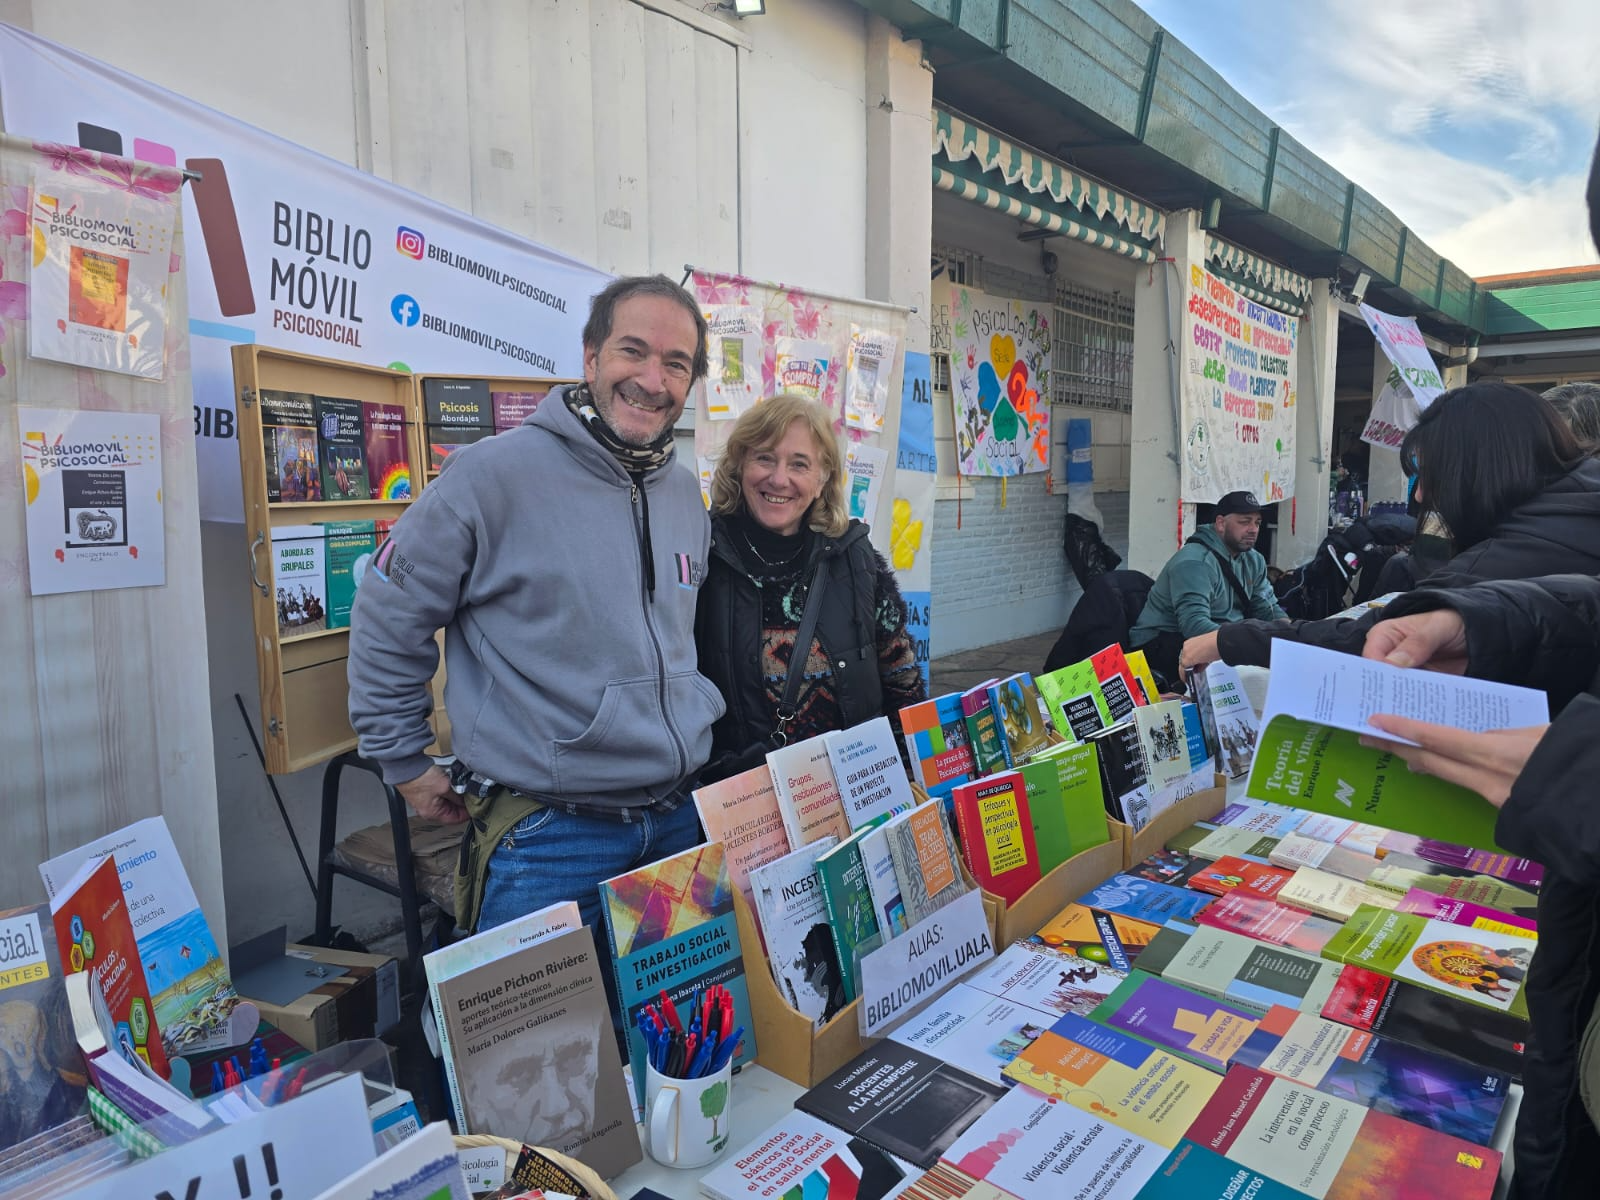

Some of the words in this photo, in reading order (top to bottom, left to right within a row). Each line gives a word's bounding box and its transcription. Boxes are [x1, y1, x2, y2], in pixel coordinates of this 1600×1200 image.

[50, 224, 137, 249] PSICOSOCIAL
[52, 211, 134, 237] BIBLIOMOVIL
[273, 201, 372, 270] BIBLIO
[269, 256, 364, 323] MÓVIL
[427, 244, 568, 314] BIBLIOMOVILPSICOSOCIAL
[273, 309, 362, 348] PSICOSOCIAL
[422, 313, 557, 376] BIBLIOMOVILPSICOSOCIAL
[440, 401, 479, 413] Psicosis
[441, 414, 480, 424] Abordajes
[40, 442, 124, 457] BIBLIOMOVIL
[41, 454, 127, 469] PSICOSOCIAL
[280, 547, 314, 558] ABORDAJES
[281, 560, 314, 572] GRUPALES
[938, 765, 963, 780] Psicología
[943, 753, 959, 767] praxis
[1265, 739, 1294, 791] Teoría
[788, 773, 814, 789] Grupos,
[857, 767, 871, 783] PARA
[864, 775, 885, 793] PROYECTO
[1285, 769, 1304, 796] del
[1304, 759, 1321, 799] Enrique
[792, 781, 833, 803] instituciones
[801, 791, 842, 816] comunidades
[1364, 775, 1386, 815] Nueva
[983, 798, 1006, 812] Enfoques
[984, 809, 1015, 826] perspectivas
[992, 819, 1018, 838] psicología
[996, 832, 1012, 846] social
[849, 851, 858, 864] LA
[782, 871, 819, 902] INCEST
[140, 893, 156, 906] una
[134, 905, 166, 928] colectiva
[1096, 915, 1114, 938] GRUPAL
[632, 942, 686, 975] TRABAJO
[689, 925, 727, 950] SOCIAL
[908, 924, 944, 962] ALIAS:
[457, 985, 504, 1013] Enrique
[504, 969, 545, 992] Pichon
[545, 952, 589, 976] Rivière:
[635, 978, 644, 992] E
[679, 982, 702, 998] Ibaceta
[867, 932, 991, 1028] BIBLIOMOVIL.UALA
[461, 1006, 490, 1026] aportes
[491, 981, 552, 1012] teórico-técnicos
[463, 1025, 474, 1036] Su
[474, 1007, 513, 1031] aplicación
[528, 985, 569, 1007] dimensión
[569, 975, 593, 990] clínica
[492, 1026, 526, 1045] Dolores
[907, 1022, 930, 1043] Futuro,
[927, 1010, 953, 1032] familia
[926, 1014, 966, 1044] discapacidad
[1201, 1027, 1219, 1053] CALIDAD
[1222, 1014, 1234, 1028] VIDA
[834, 1073, 856, 1090] Lucas
[848, 1063, 896, 1098] DOCENTES
[865, 1059, 919, 1099] INTEMPERIE
[1118, 1096, 1130, 1107] La
[1126, 1076, 1150, 1100] violencia
[1147, 1055, 1169, 1078] cotidiana
[1132, 1104, 1140, 1113] en
[1159, 1063, 1178, 1084] escolar
[1243, 1075, 1264, 1103] Carballeda
[847, 1104, 861, 1114] A
[853, 1096, 871, 1108] LA
[1231, 1098, 1248, 1121] Manuel
[1300, 1093, 1316, 1118] social
[1226, 1116, 1237, 1133] Juan
[1259, 1129, 1273, 1145] La
[1268, 1089, 1300, 1134] intervención
[1288, 1123, 1298, 1136] en
[1292, 1113, 1303, 1126] lo
[1297, 1125, 1314, 1152] como
[1308, 1100, 1331, 1132] proceso
[735, 1130, 789, 1171] Elementos
[1051, 1146, 1086, 1176] Violencia
[1080, 1122, 1105, 1147] escolar
[1210, 1127, 1229, 1149] Alfredo
[741, 1149, 783, 1180] básicos
[779, 1134, 804, 1154] para
[747, 1181, 760, 1193] el
[757, 1155, 796, 1185] Trabajo
[792, 1131, 825, 1157] Social
[761, 1185, 777, 1198] en
[775, 1164, 804, 1187] salud
[802, 1138, 835, 1167] mental
[1022, 1150, 1058, 1183] Violencia
[1053, 1131, 1074, 1154] social
[1119, 1143, 1146, 1175] legalidades
[1090, 1167, 1106, 1190] puesta
[1221, 1168, 1250, 1200] DISEÑAR
[1298, 1174, 1310, 1190] Una
